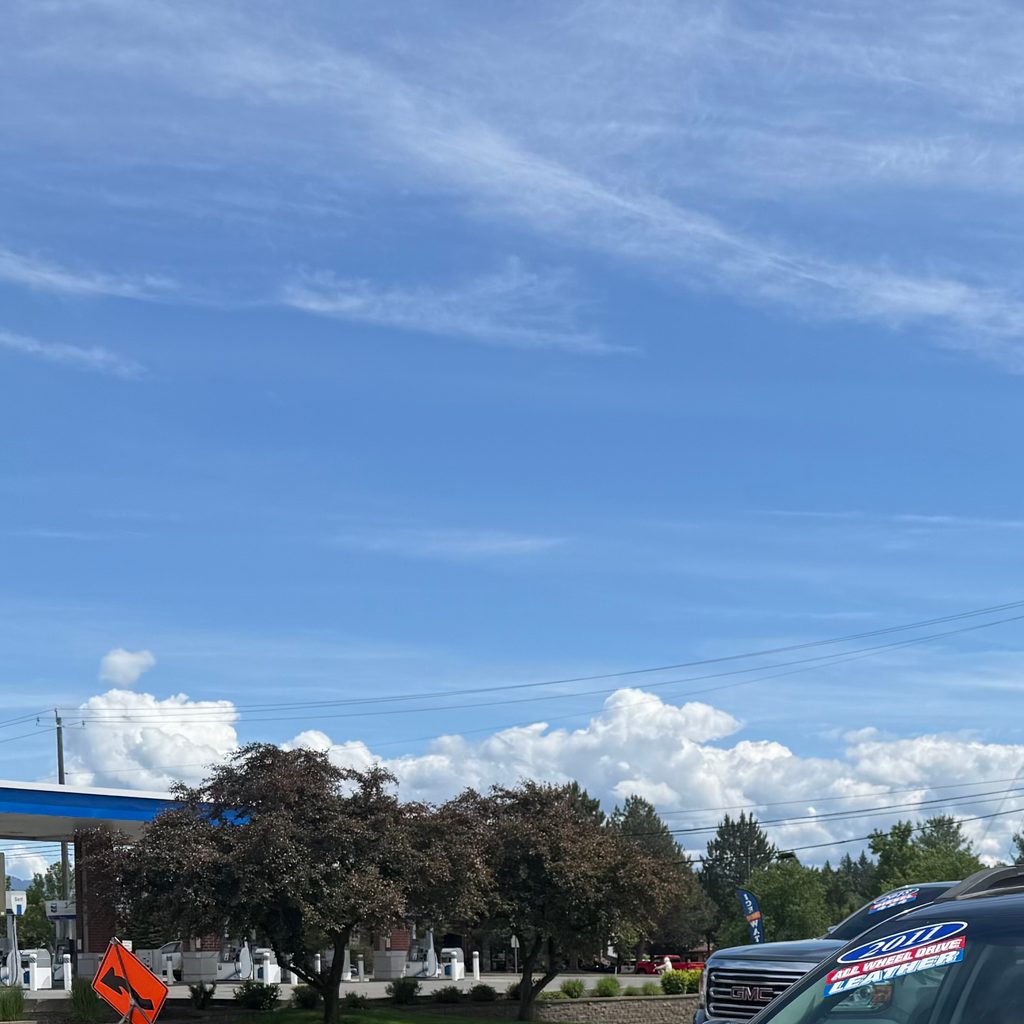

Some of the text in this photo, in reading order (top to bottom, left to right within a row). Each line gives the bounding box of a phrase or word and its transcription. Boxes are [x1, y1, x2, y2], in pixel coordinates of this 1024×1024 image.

[828, 950, 961, 996] LEATHER
[831, 938, 963, 981] ALL WHEEL DRIVE
[730, 985, 774, 1002] GMC
